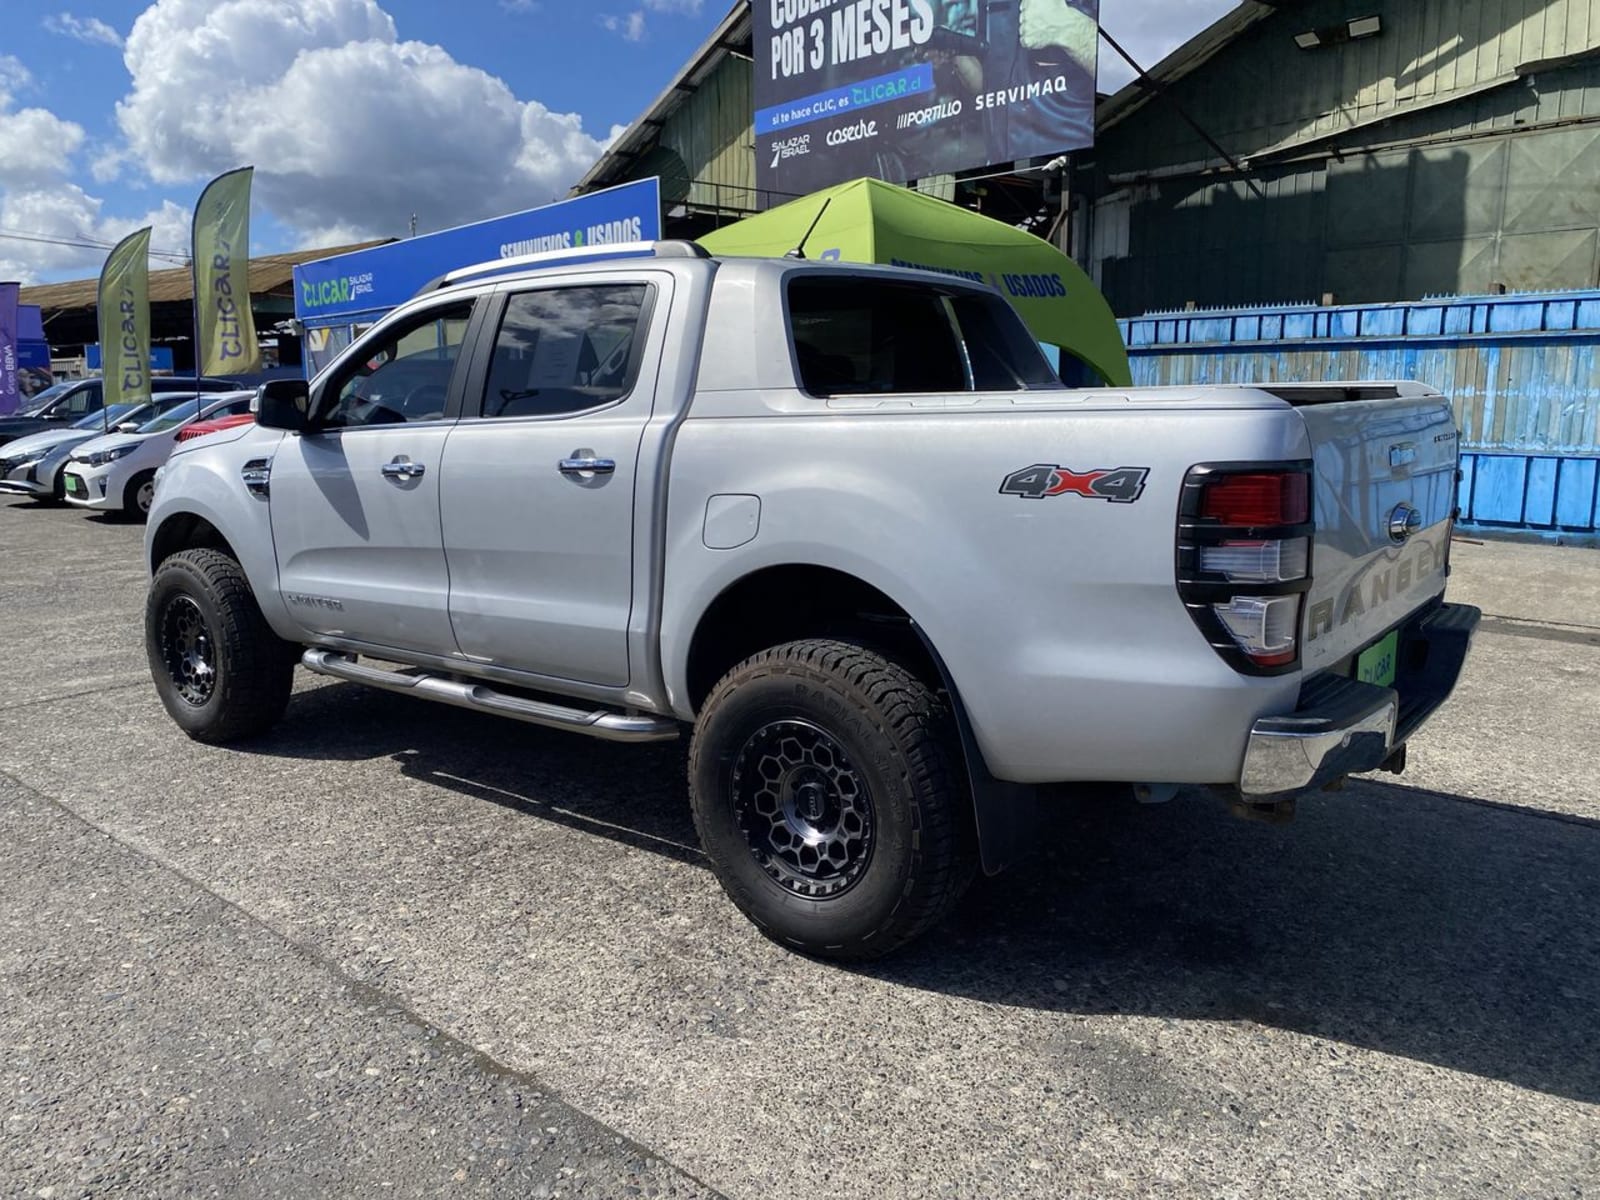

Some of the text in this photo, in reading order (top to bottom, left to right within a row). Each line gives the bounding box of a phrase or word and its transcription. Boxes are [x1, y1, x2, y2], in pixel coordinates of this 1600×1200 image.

[771, 26, 805, 80] POR
[810, 18, 825, 71] 3
[831, 0, 935, 65] MESES
[975, 75, 1068, 111] SERVIMAQ
[772, 115, 780, 125] si
[780, 112, 791, 123] te
[791, 106, 812, 120] hace
[838, 96, 850, 108] es
[771, 134, 811, 153] SALAZAR
[587, 216, 642, 247] USADOS
[1001, 273, 1067, 298] USADOS
[4, 344, 15, 371] BBVA
